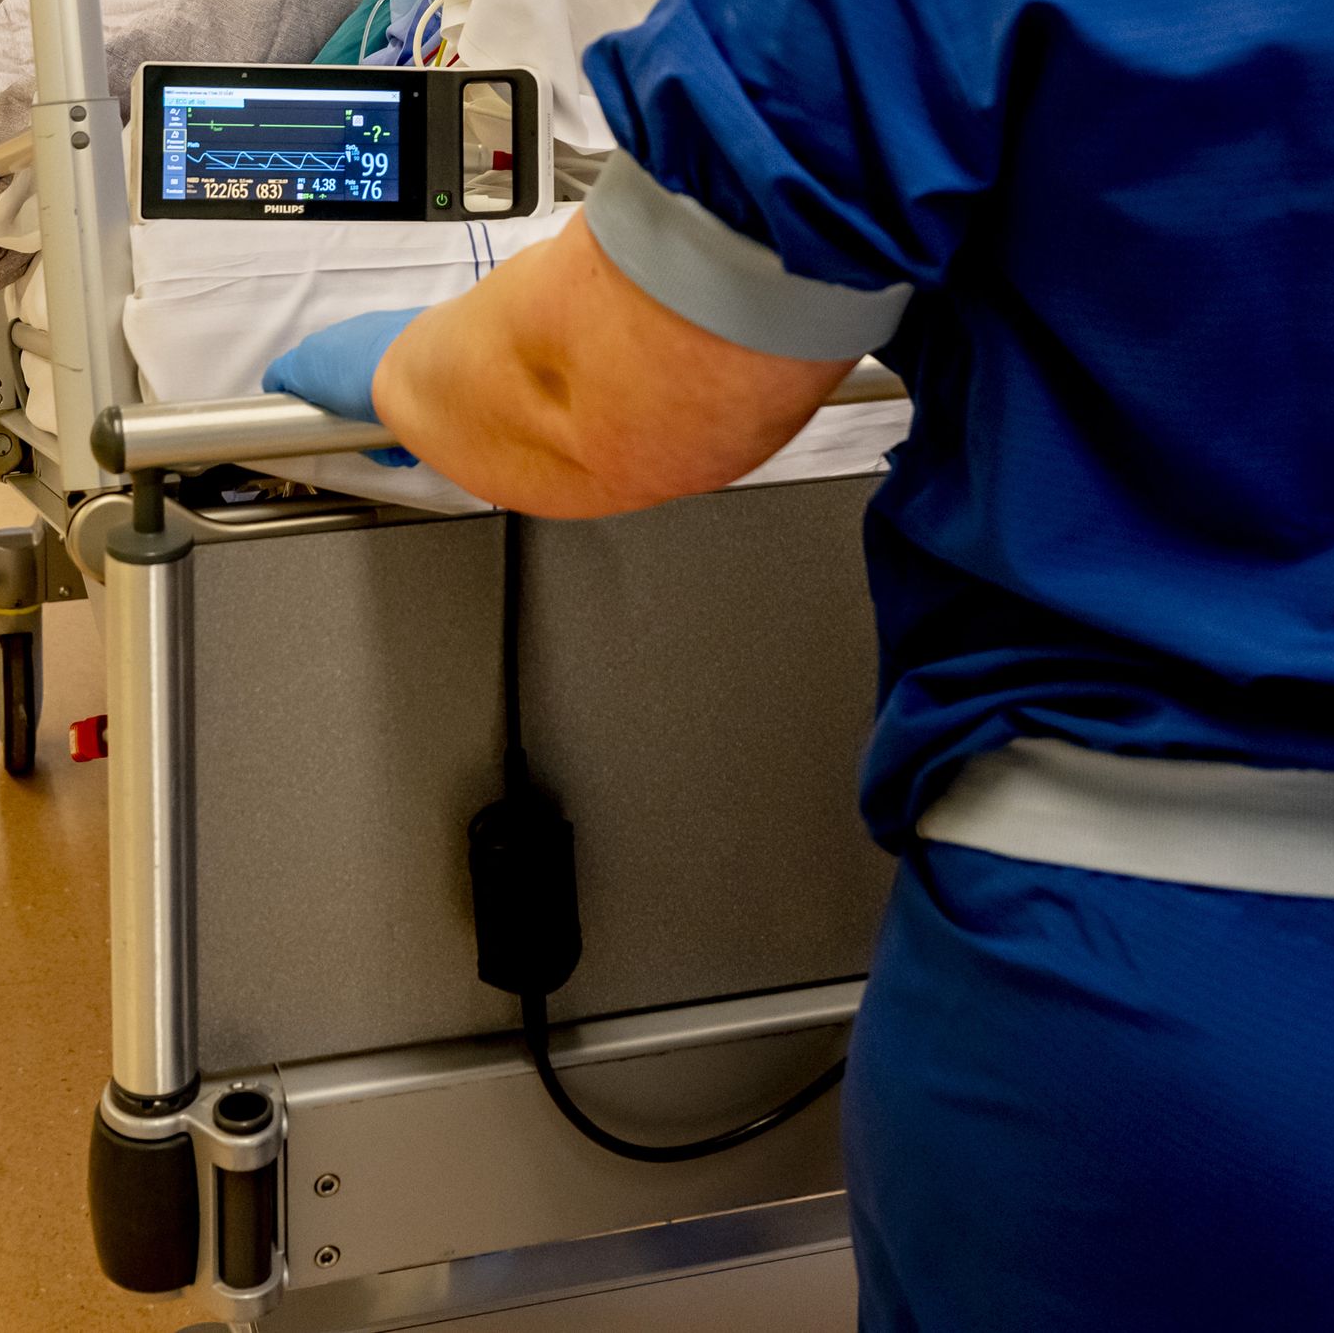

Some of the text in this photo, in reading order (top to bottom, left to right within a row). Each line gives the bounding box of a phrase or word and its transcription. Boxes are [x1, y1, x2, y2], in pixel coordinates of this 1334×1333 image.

[361, 152, 389, 178] 99
[203, 182, 249, 199] 122/65
[255, 183, 283, 200] (83)
[311, 177, 337, 192] 4.38
[359, 179, 383, 200] 76
[264, 204, 305, 214] PHILIPS
